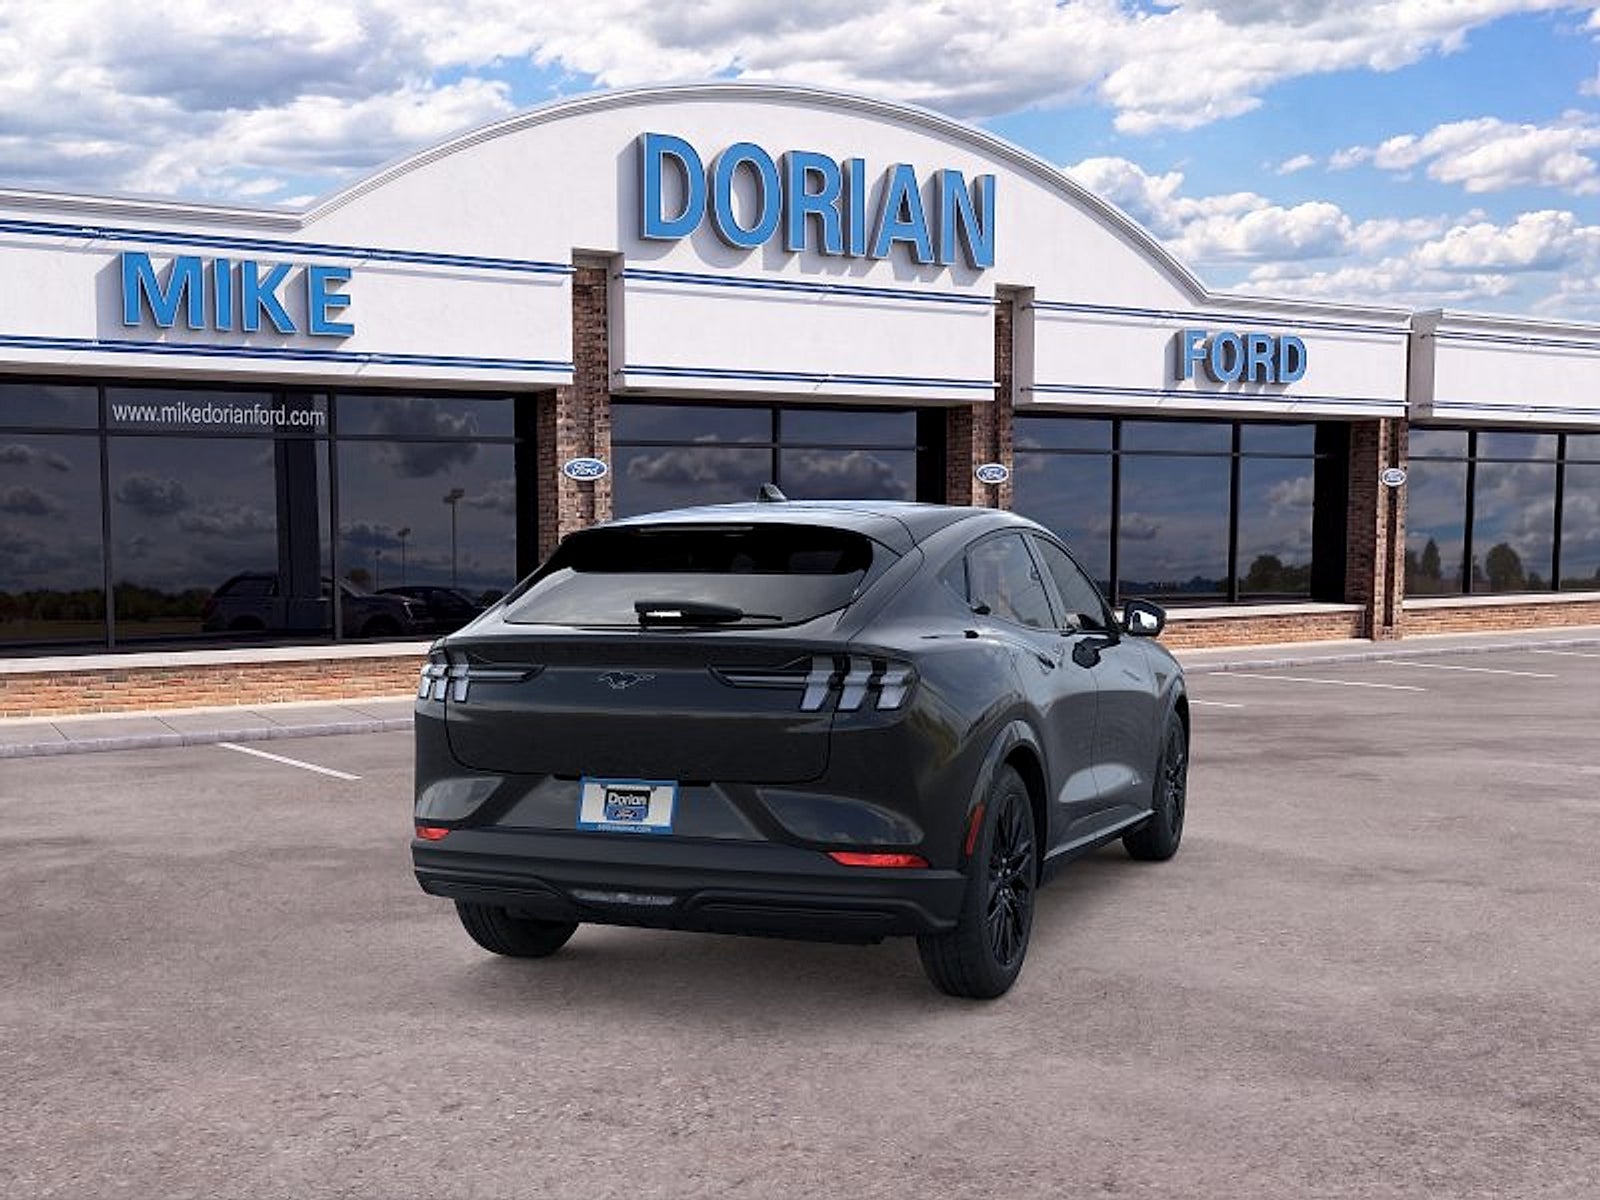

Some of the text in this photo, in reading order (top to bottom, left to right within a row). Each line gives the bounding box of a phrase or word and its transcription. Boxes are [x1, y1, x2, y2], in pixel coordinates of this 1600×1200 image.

[641, 132, 996, 270] DORIAN
[121, 251, 355, 337] MIKE
[1178, 327, 1308, 384] FORD
[112, 402, 326, 426] www.mikedorianford.com
[608, 792, 648, 805] Dorian
